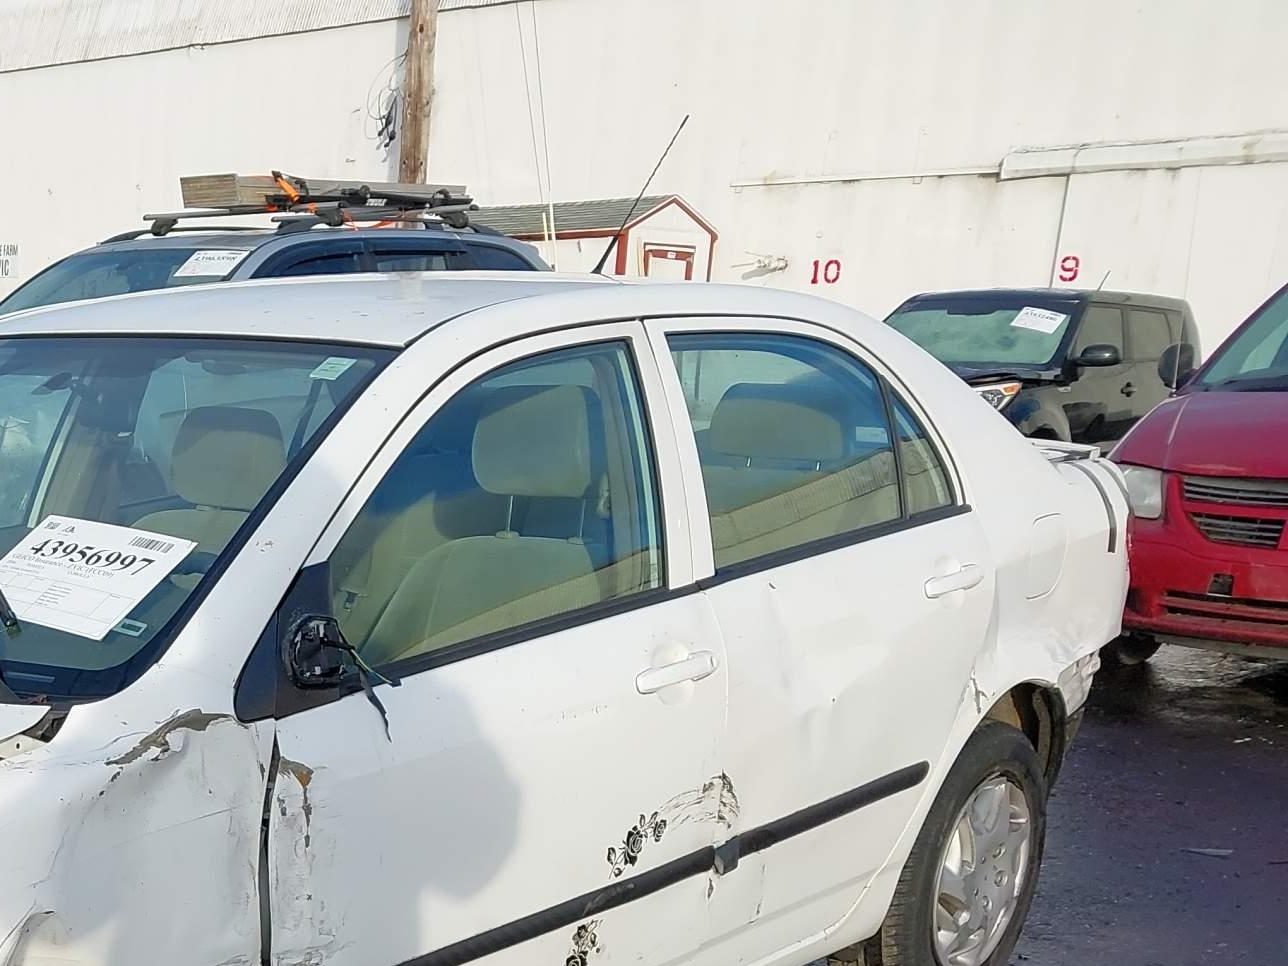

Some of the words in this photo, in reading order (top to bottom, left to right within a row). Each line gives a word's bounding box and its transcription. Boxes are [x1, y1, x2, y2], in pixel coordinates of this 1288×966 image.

[3, 244, 19, 257] FARM
[810, 259, 842, 284] 10
[1058, 256, 1080, 282] 9
[30, 538, 156, 576] 43956997
